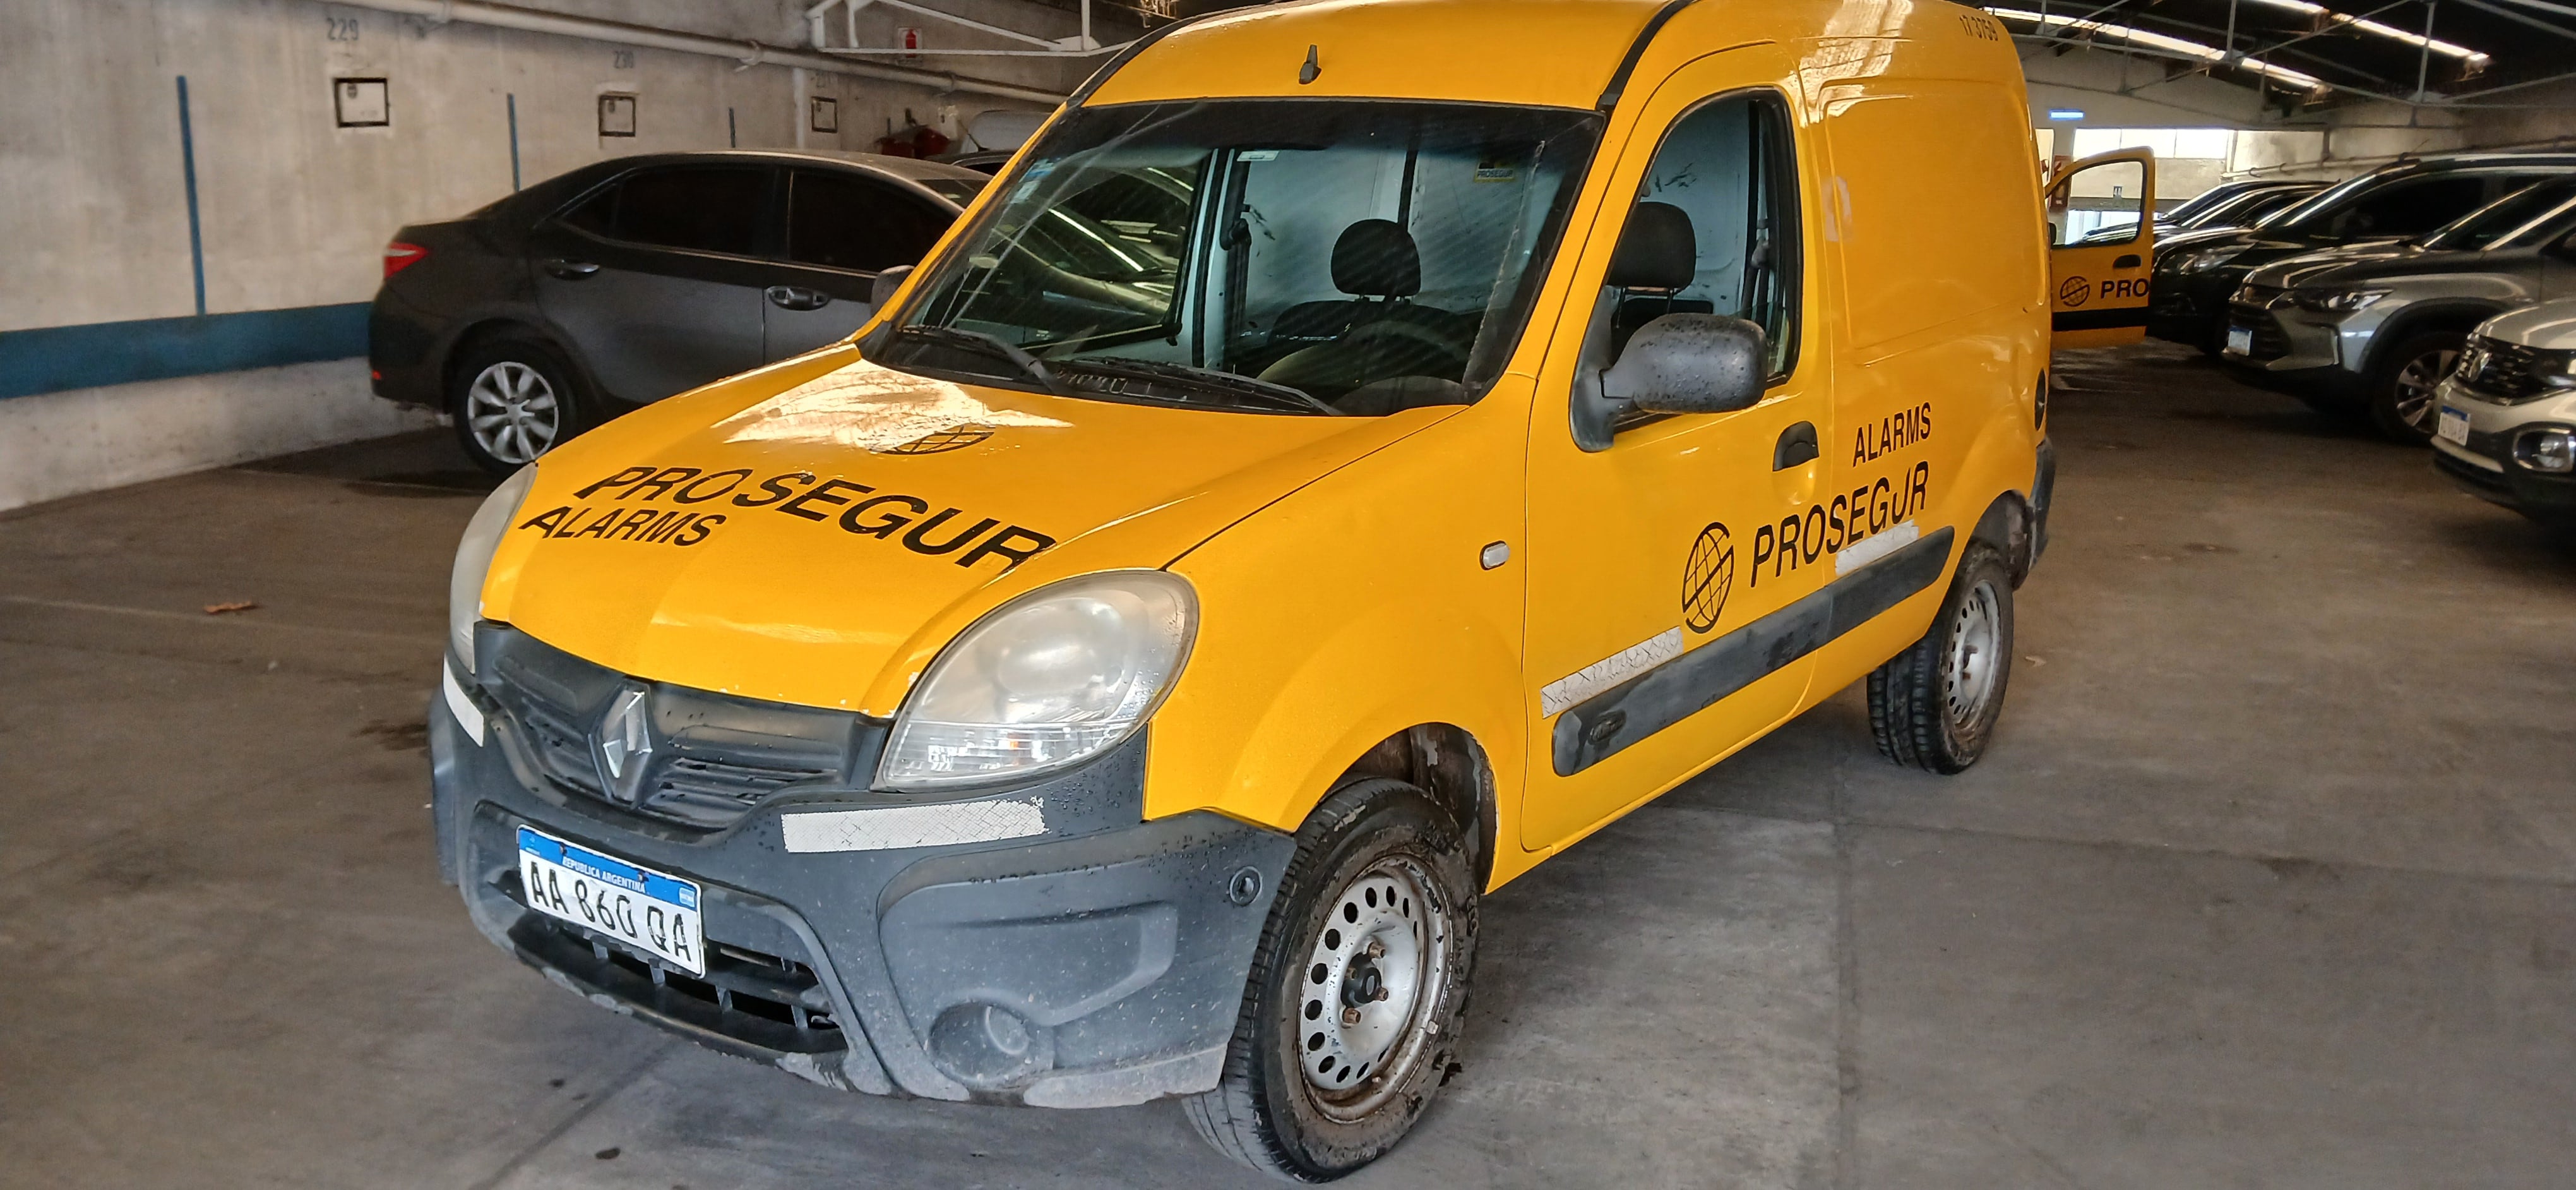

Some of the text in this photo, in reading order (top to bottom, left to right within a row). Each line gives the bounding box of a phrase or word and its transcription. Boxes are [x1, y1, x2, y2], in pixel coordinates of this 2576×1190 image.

[326, 17, 359, 40] 229
[2100, 278, 2150, 299] PRO
[1852, 402, 1932, 467] ALARMS
[518, 506, 727, 546] ALARMS
[573, 467, 1058, 575] PROSEGUR
[1750, 461, 1929, 588] PROSEGUR
[602, 871, 646, 894] ARGENTINA
[530, 861, 692, 962] AA 860 QA
